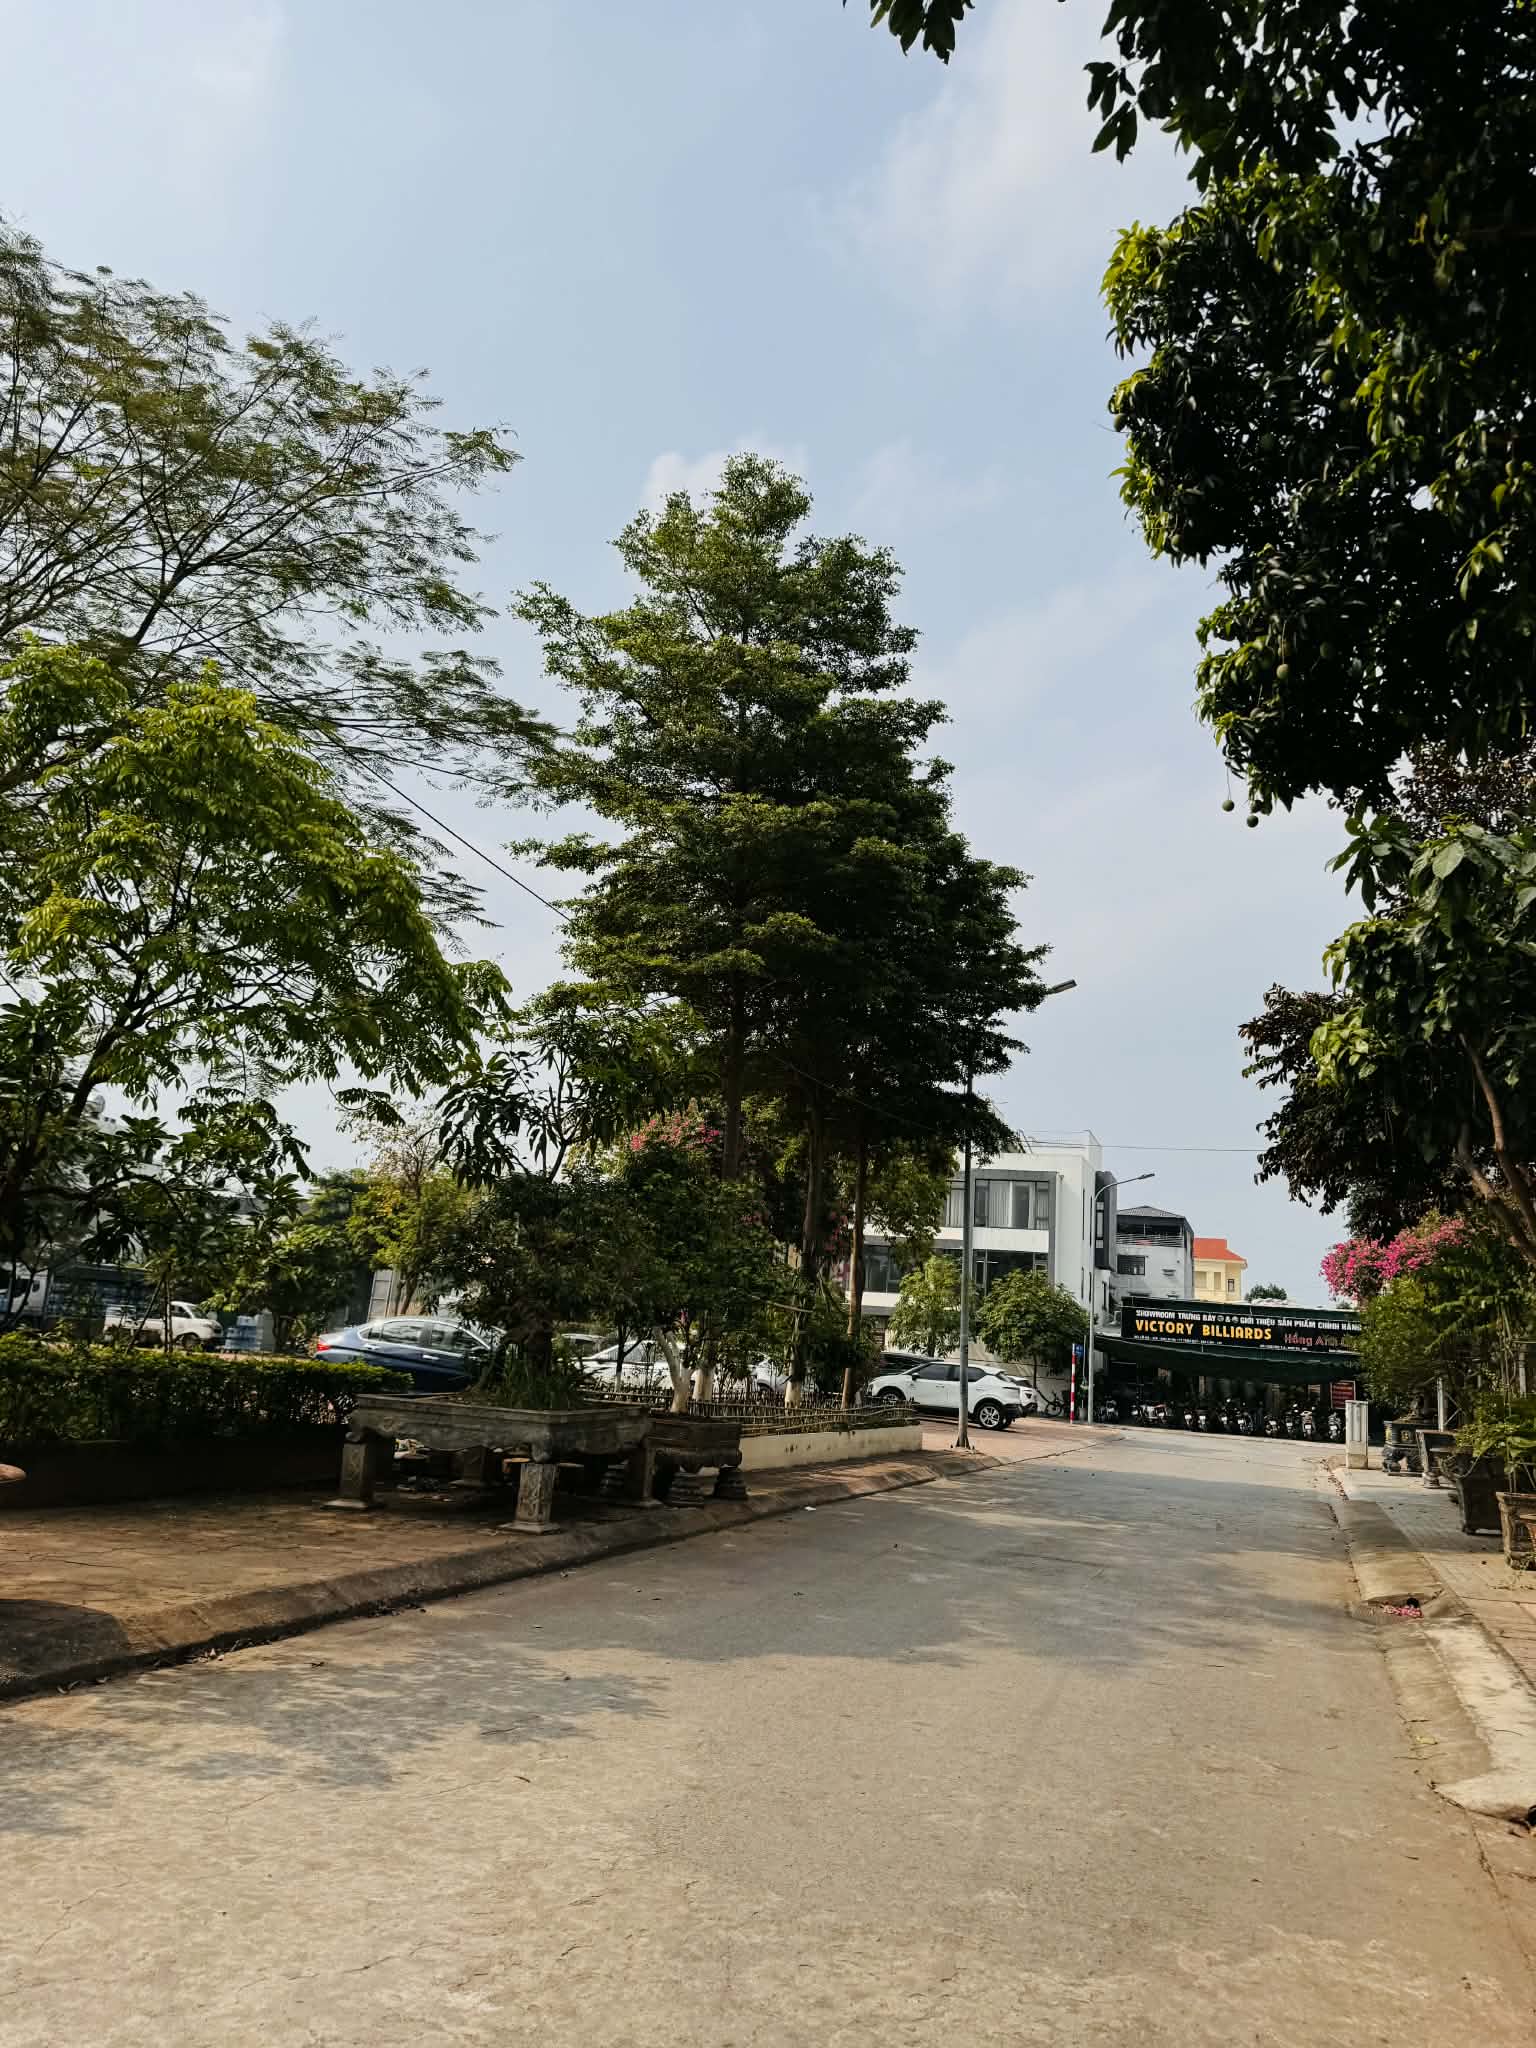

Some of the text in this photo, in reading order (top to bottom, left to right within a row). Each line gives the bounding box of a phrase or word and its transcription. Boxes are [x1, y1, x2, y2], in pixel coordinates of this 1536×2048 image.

[1136, 1310, 1175, 1319] SHOWROOM
[1135, 1319, 1194, 1335] VICTORY
[1202, 1324, 1272, 1340] BILLIARDS
